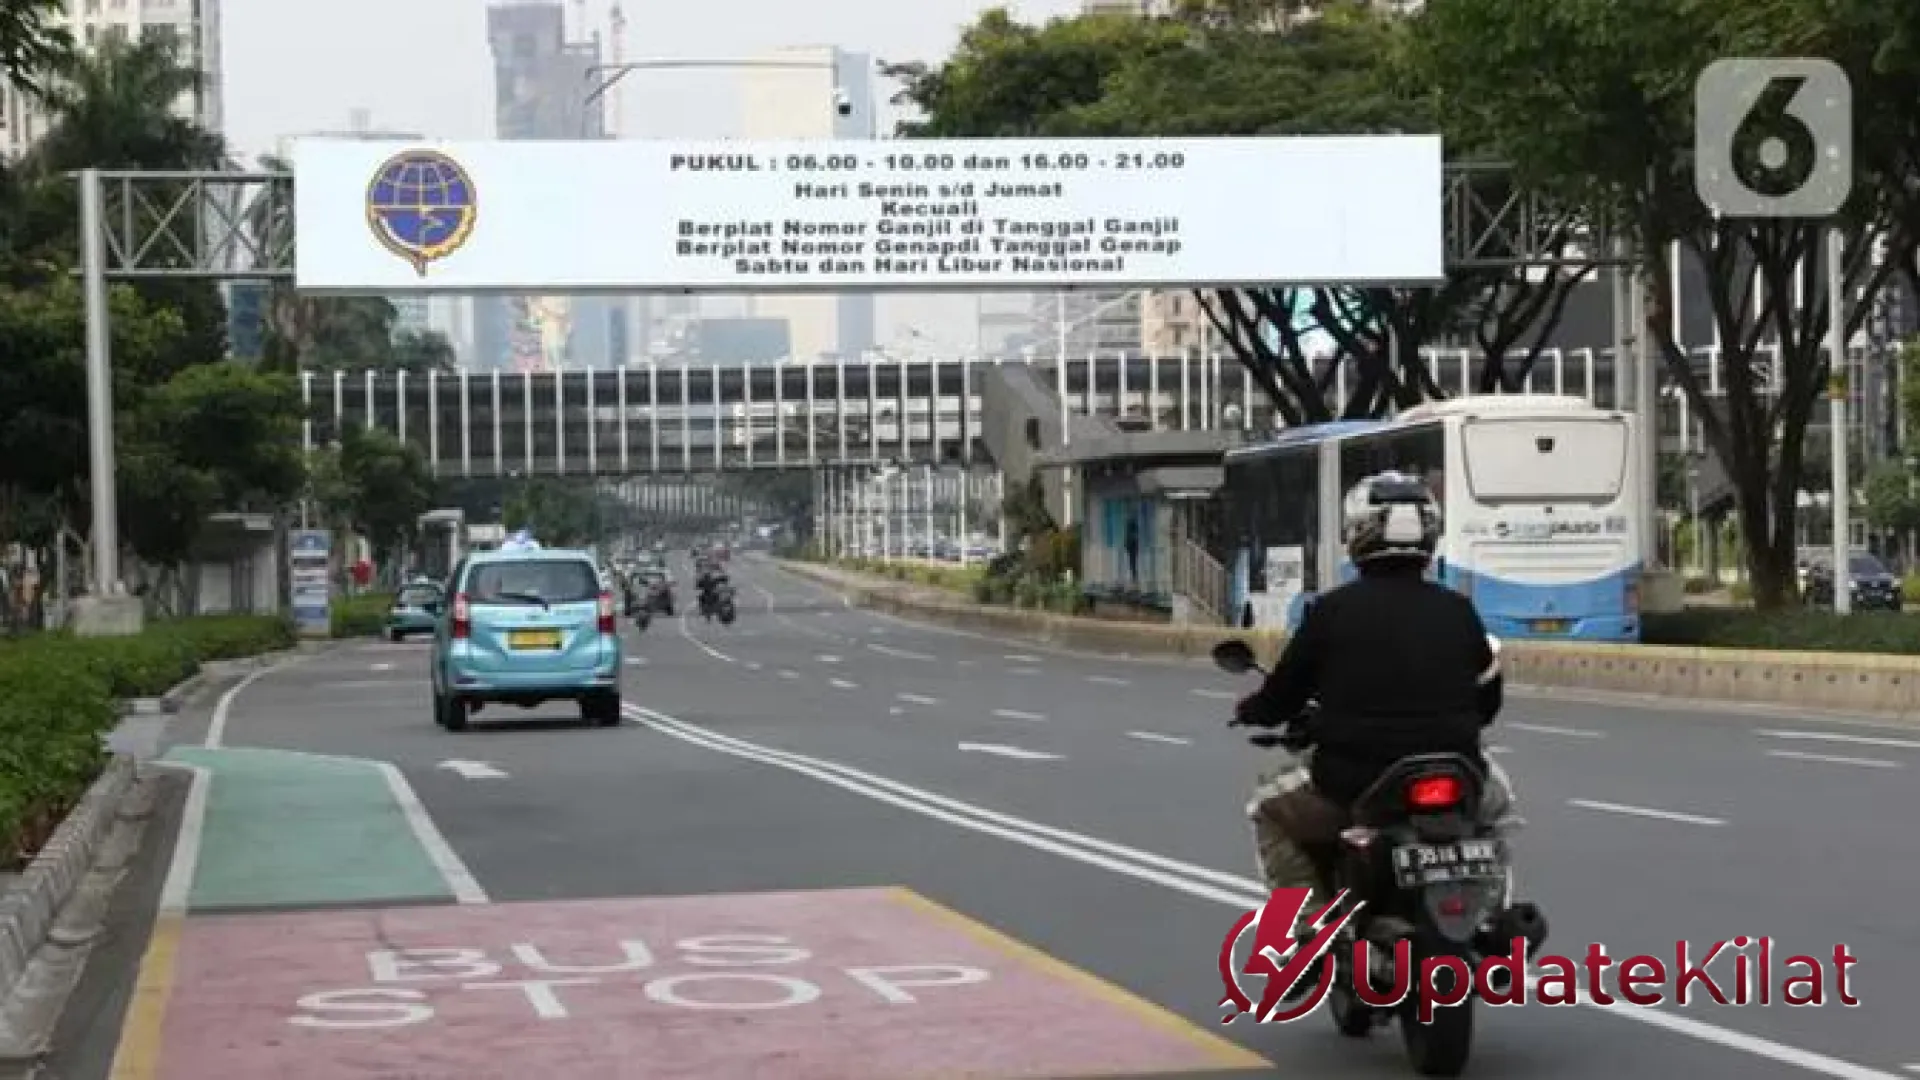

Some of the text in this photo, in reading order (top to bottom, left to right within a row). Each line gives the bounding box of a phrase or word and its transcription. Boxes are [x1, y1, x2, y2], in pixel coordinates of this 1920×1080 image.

[669, 153, 761, 172] PUKUL
[786, 153, 859, 171] 06.00
[884, 153, 955, 171] 10.00
[963, 153, 1011, 170] dan
[1020, 153, 1090, 170] 16.00
[1114, 153, 1185, 170] 21.00
[794, 181, 1063, 199] Hari Senin s/d Jumat
[880, 199, 979, 217] Kecuali
[678, 217, 1179, 239] Berplat Nomor Ganjil di Tanggal Ganjil
[675, 239, 772, 260] Berplat
[781, 238, 866, 256] Nomor
[987, 237, 1092, 257] Tanggal
[1100, 237, 1182, 256] Genap
[735, 256, 1125, 274] Sabtu dan Hari Libur Nasional
[366, 933, 813, 983] BUS
[287, 964, 992, 1028] STOP
